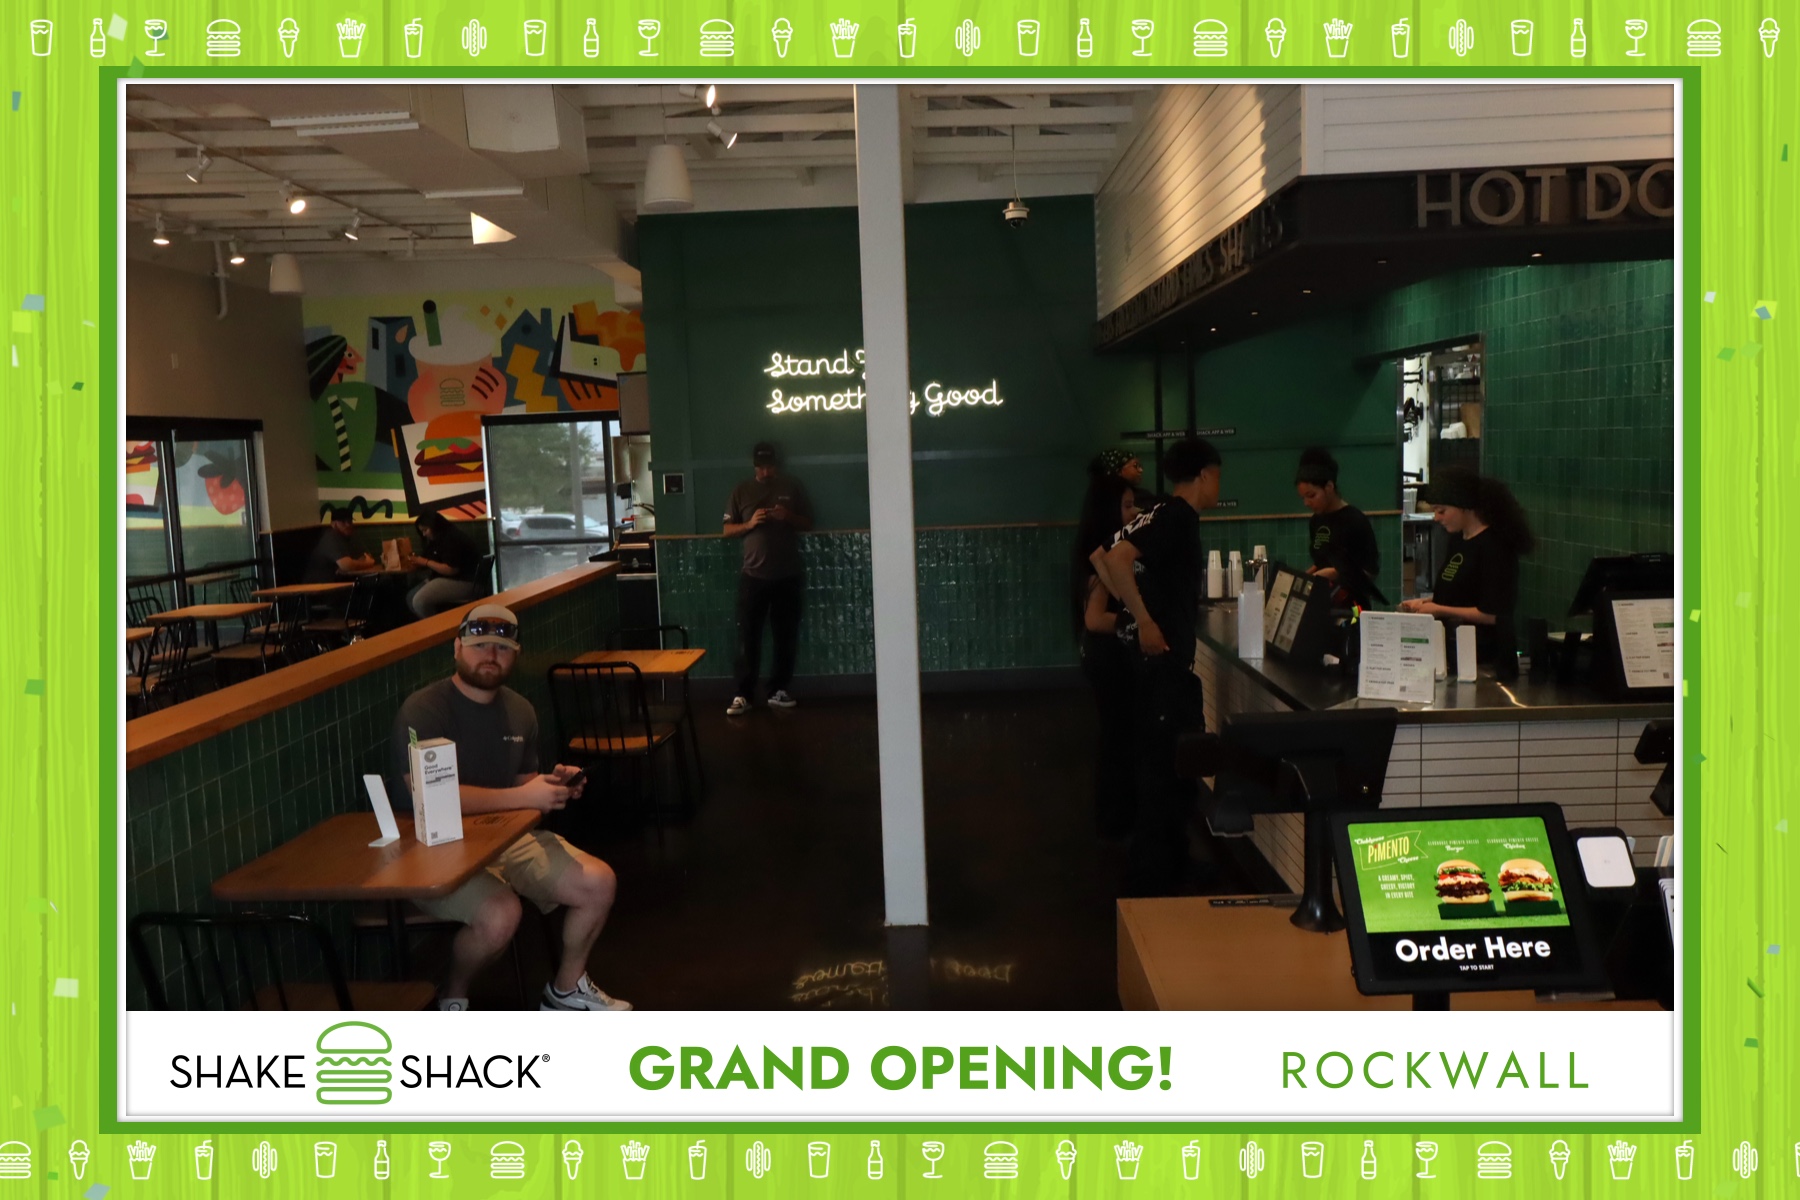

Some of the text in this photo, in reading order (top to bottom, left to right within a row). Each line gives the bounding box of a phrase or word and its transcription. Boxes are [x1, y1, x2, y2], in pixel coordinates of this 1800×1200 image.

[1417, 167, 1567, 229] HOT
[764, 348, 856, 379] Stand
[924, 377, 1004, 418] Good
[1395, 936, 1552, 962] Order Here
